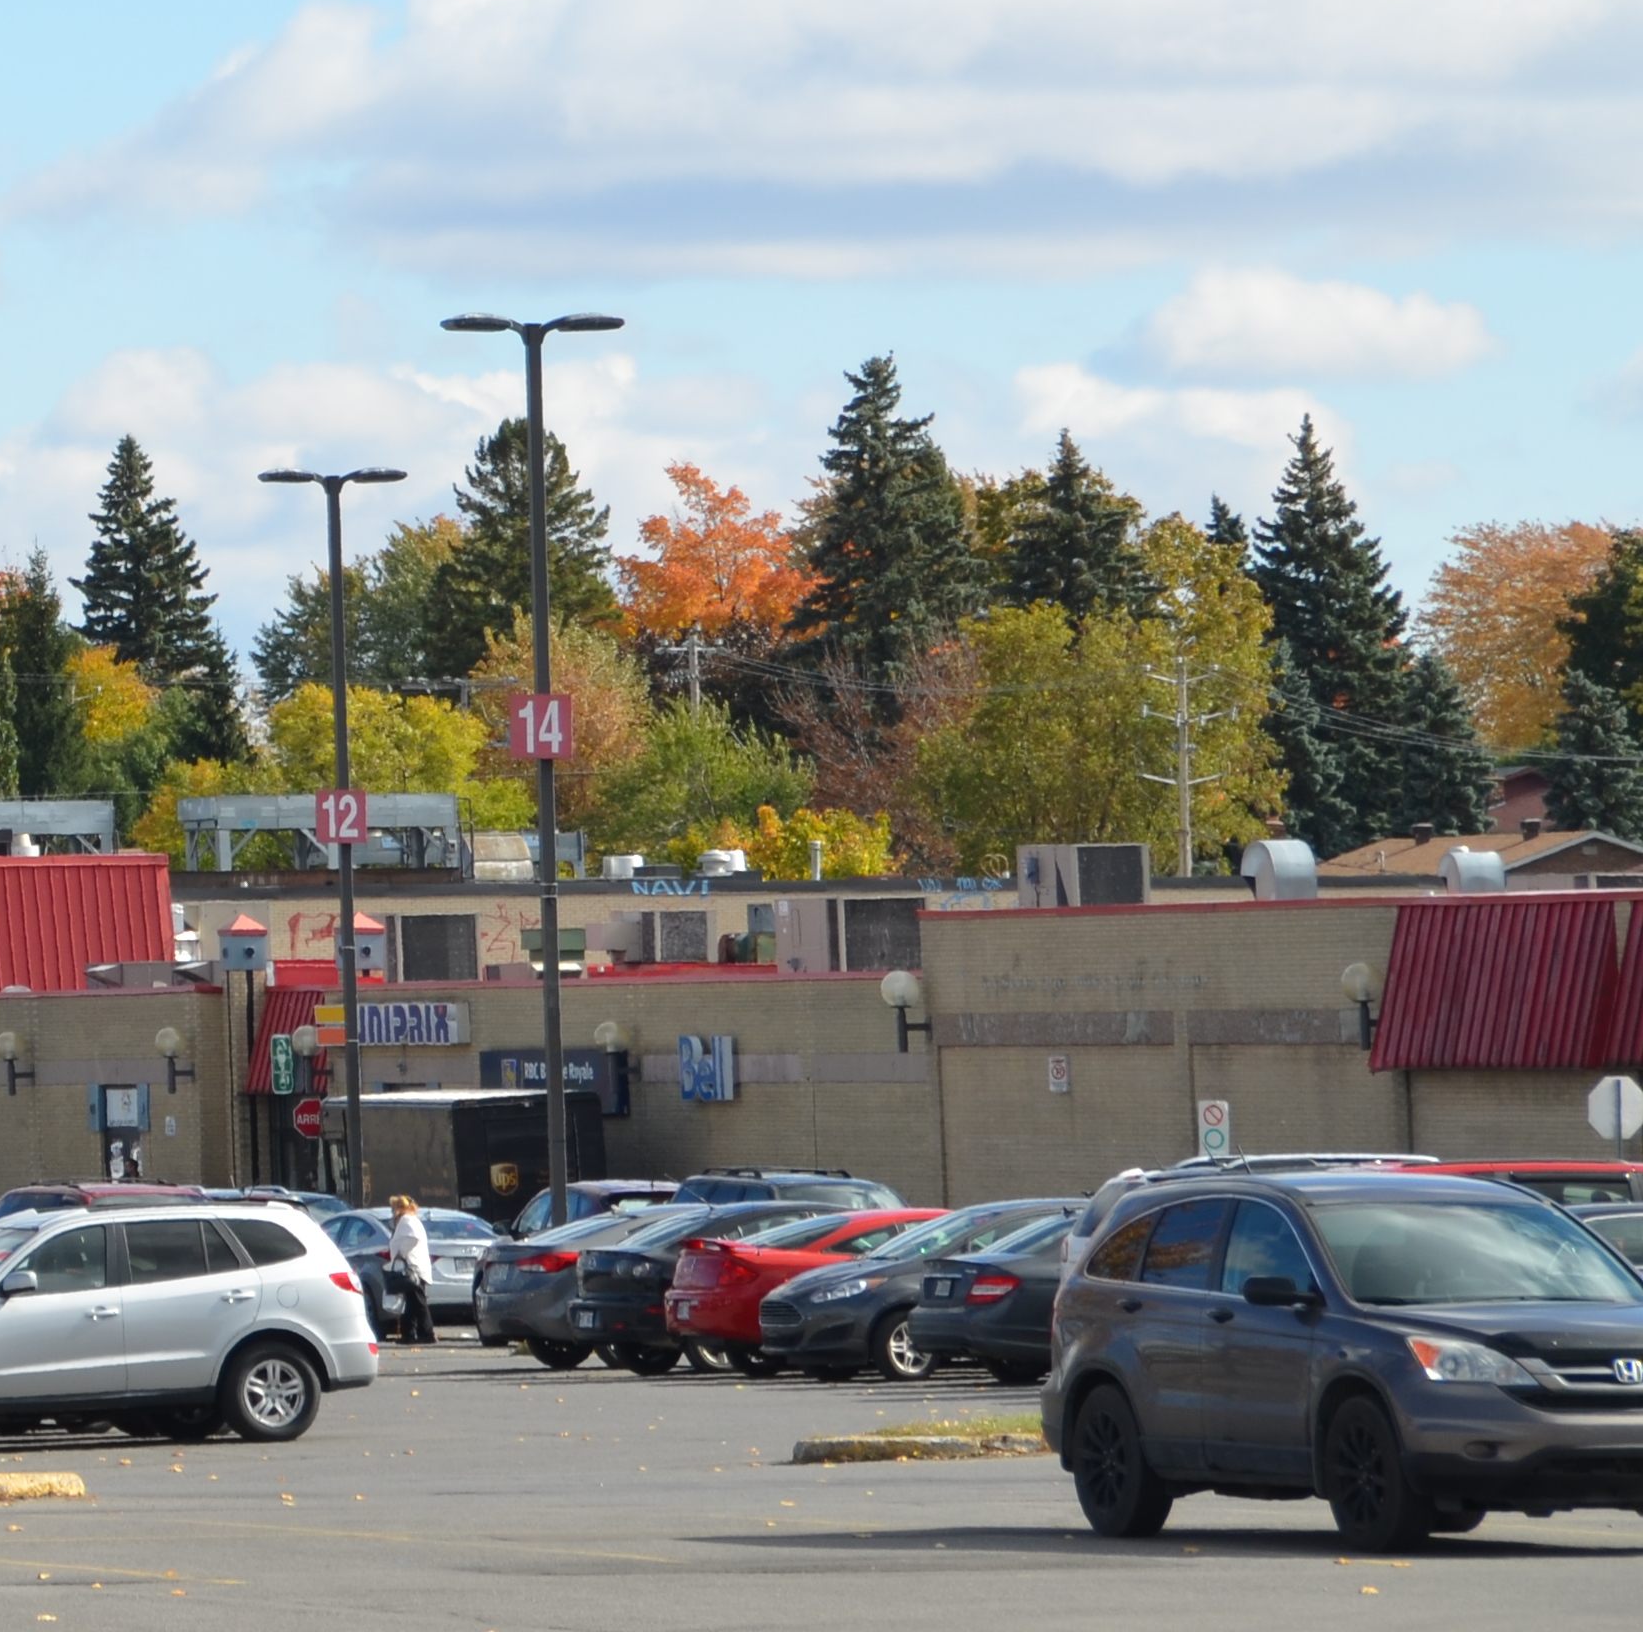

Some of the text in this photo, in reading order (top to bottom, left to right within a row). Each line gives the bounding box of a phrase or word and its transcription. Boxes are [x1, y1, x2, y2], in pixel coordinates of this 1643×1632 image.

[518, 699, 564, 755] 14
[321, 794, 359, 838] 12
[523, 1062, 538, 1079] RBC
[568, 1061, 594, 1084] Royale
[679, 1036, 728, 1101] Bell
[494, 1173, 516, 1190] ups
